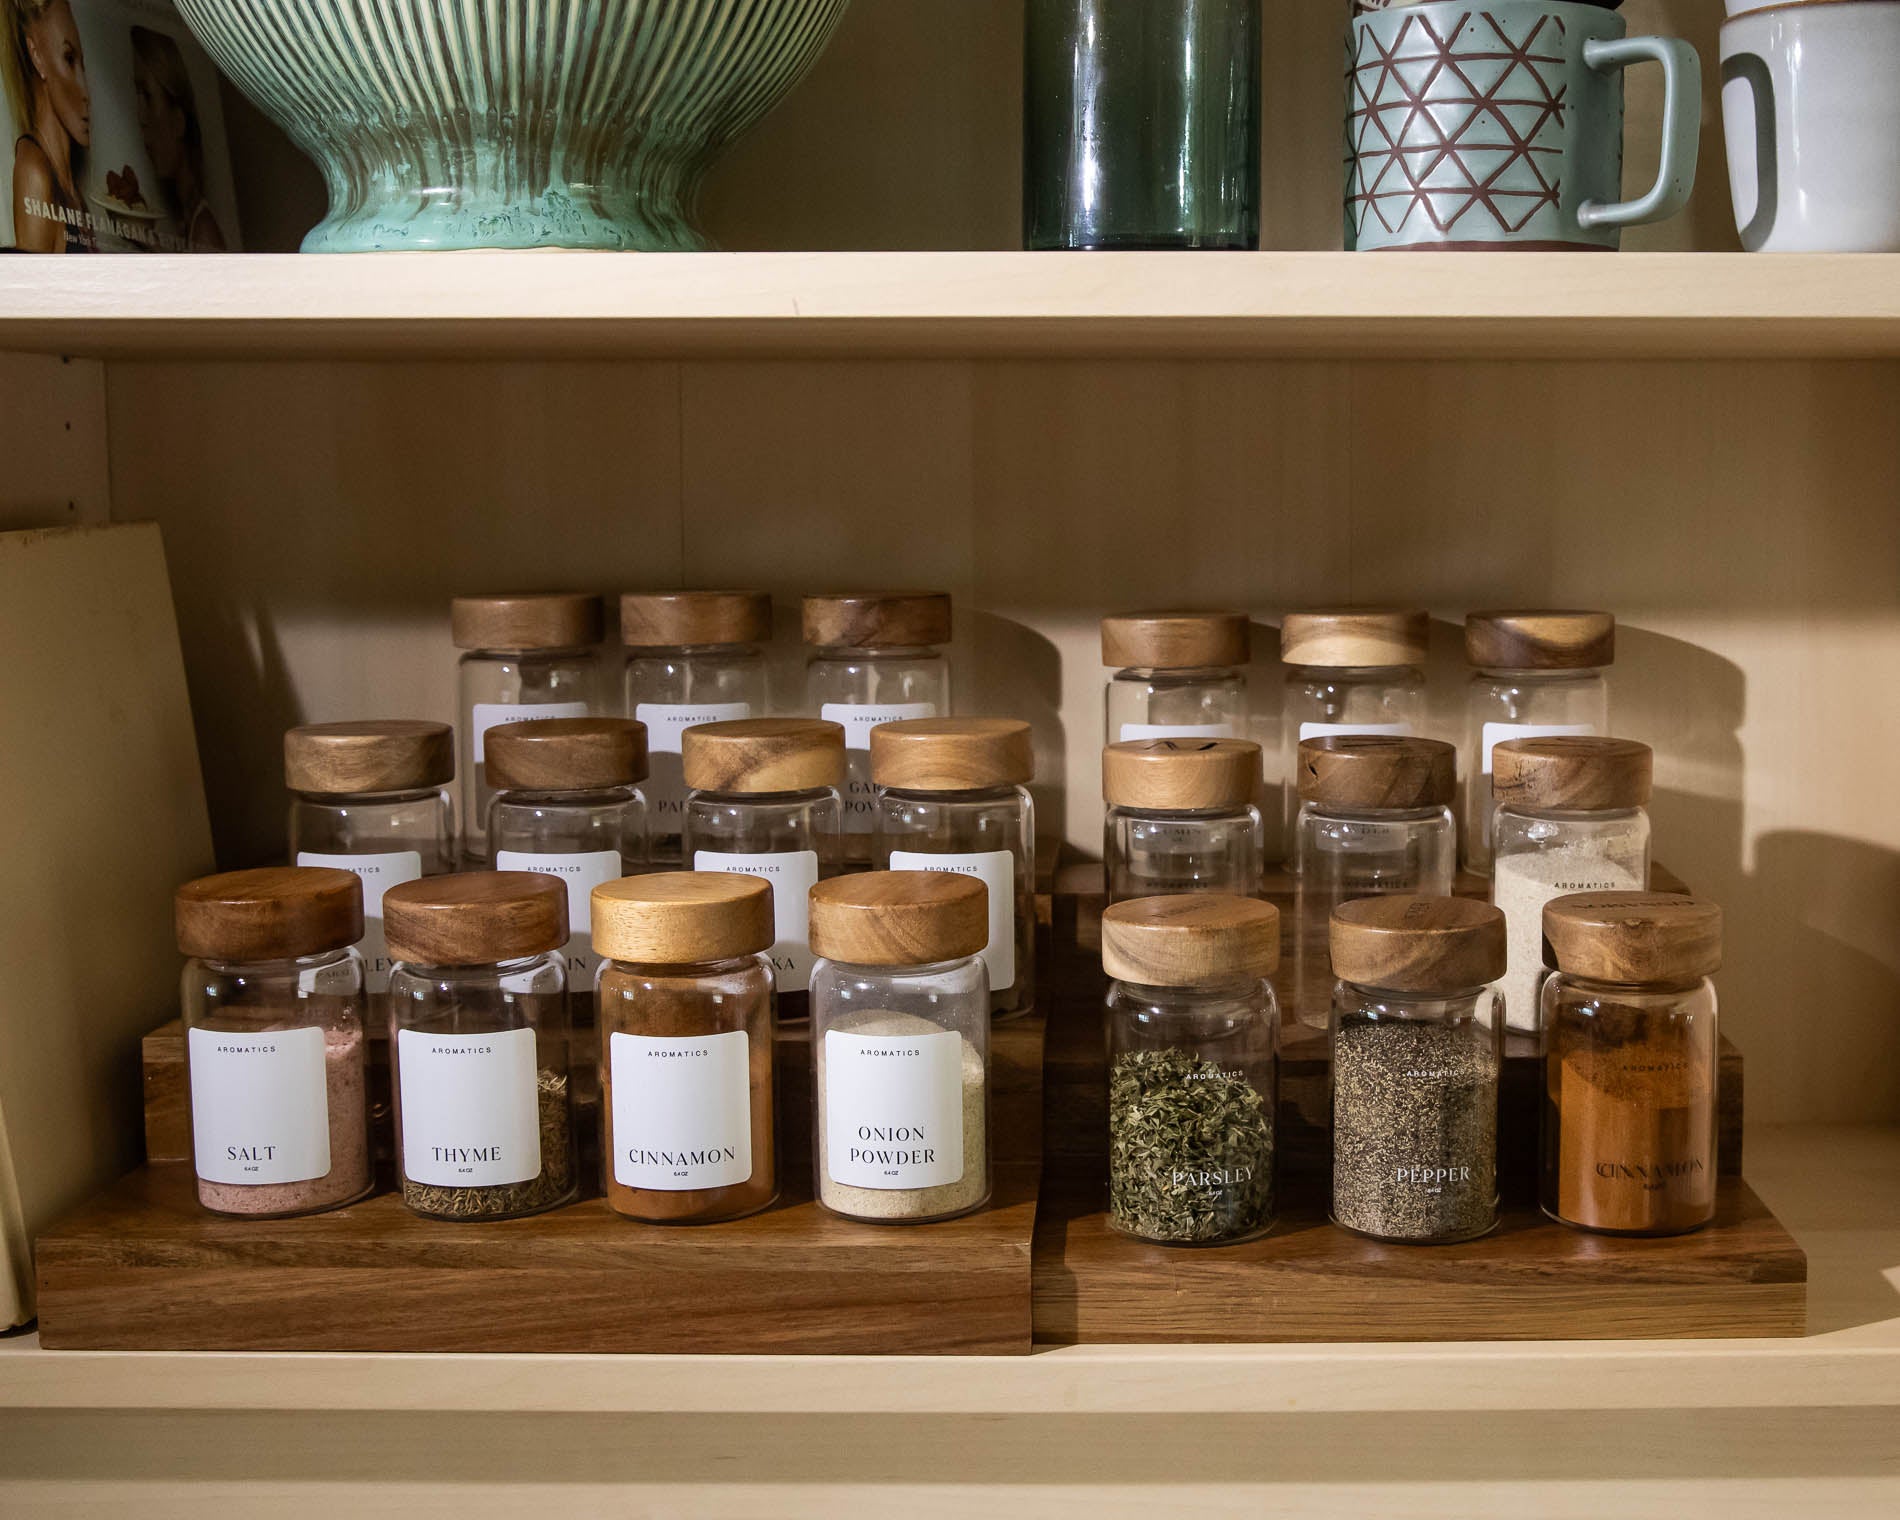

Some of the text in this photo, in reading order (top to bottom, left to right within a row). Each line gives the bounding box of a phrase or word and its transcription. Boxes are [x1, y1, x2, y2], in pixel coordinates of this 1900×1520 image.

[23, 197, 84, 227] SHALANE
[1554, 881, 1616, 889] AROMATICS
[217, 1045, 277, 1054] AROMATICS
[431, 1046, 492, 1055] AROMATICS
[647, 1049, 709, 1057] AROMATICS
[860, 1048, 921, 1057] AROMATICS
[1186, 1069, 1244, 1080] AROMATICS
[1406, 1069, 1465, 1078] AROMATICS
[858, 1125, 925, 1143] ONION
[226, 1144, 277, 1162] SALT
[431, 1145, 502, 1163] THYME
[628, 1146, 736, 1167] CINNAMON
[849, 1147, 936, 1166] POWDER
[1172, 1165, 1255, 1187] PARSLEY
[1396, 1166, 1471, 1183] PEPPER
